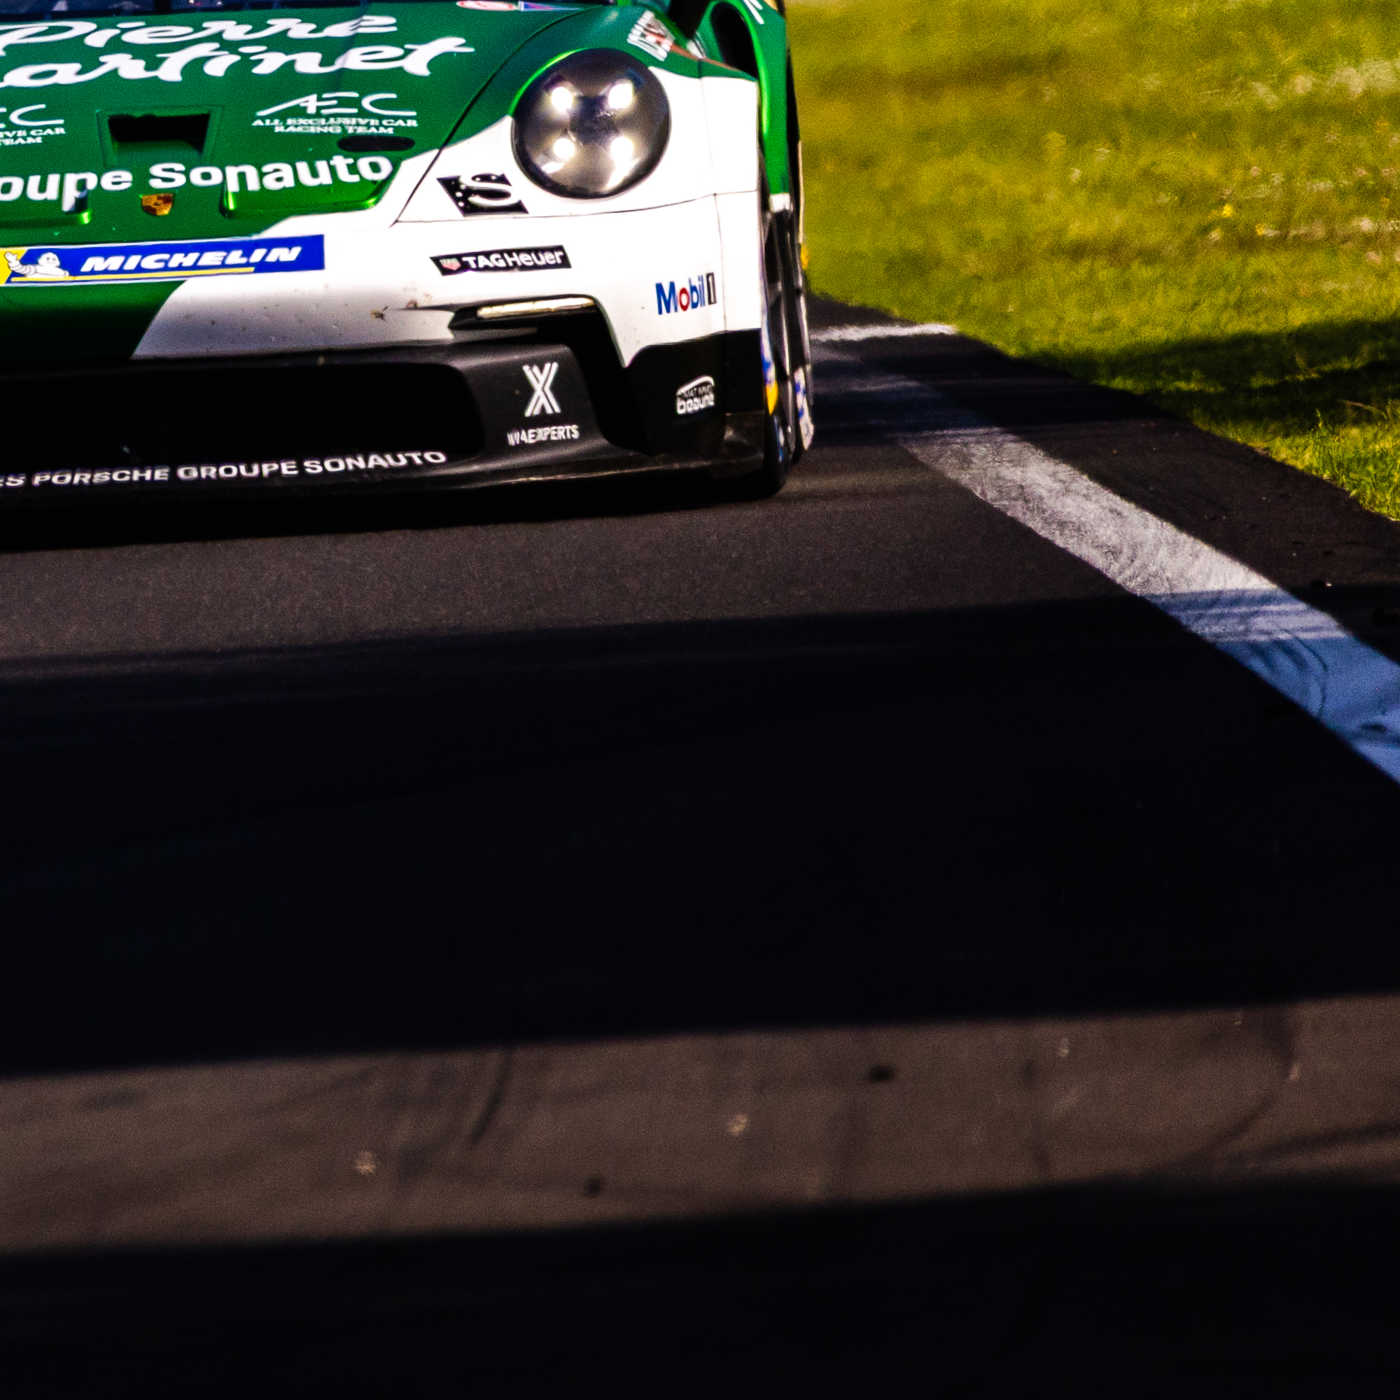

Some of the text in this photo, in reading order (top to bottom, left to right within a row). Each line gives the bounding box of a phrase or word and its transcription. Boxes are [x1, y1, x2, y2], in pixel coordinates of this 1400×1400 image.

[30, 127, 66, 136] CAR
[251, 117, 418, 128] ALL EXCLUSIVE CAR
[274, 125, 394, 135] RACING TEAM
[148, 154, 394, 192] Sonauto
[80, 246, 303, 273] MICHELIN
[655, 274, 705, 315] Mobil
[32, 466, 170, 486] PORSCHE
[177, 459, 299, 481] GROUPE
[303, 451, 447, 475] SONAUTO
